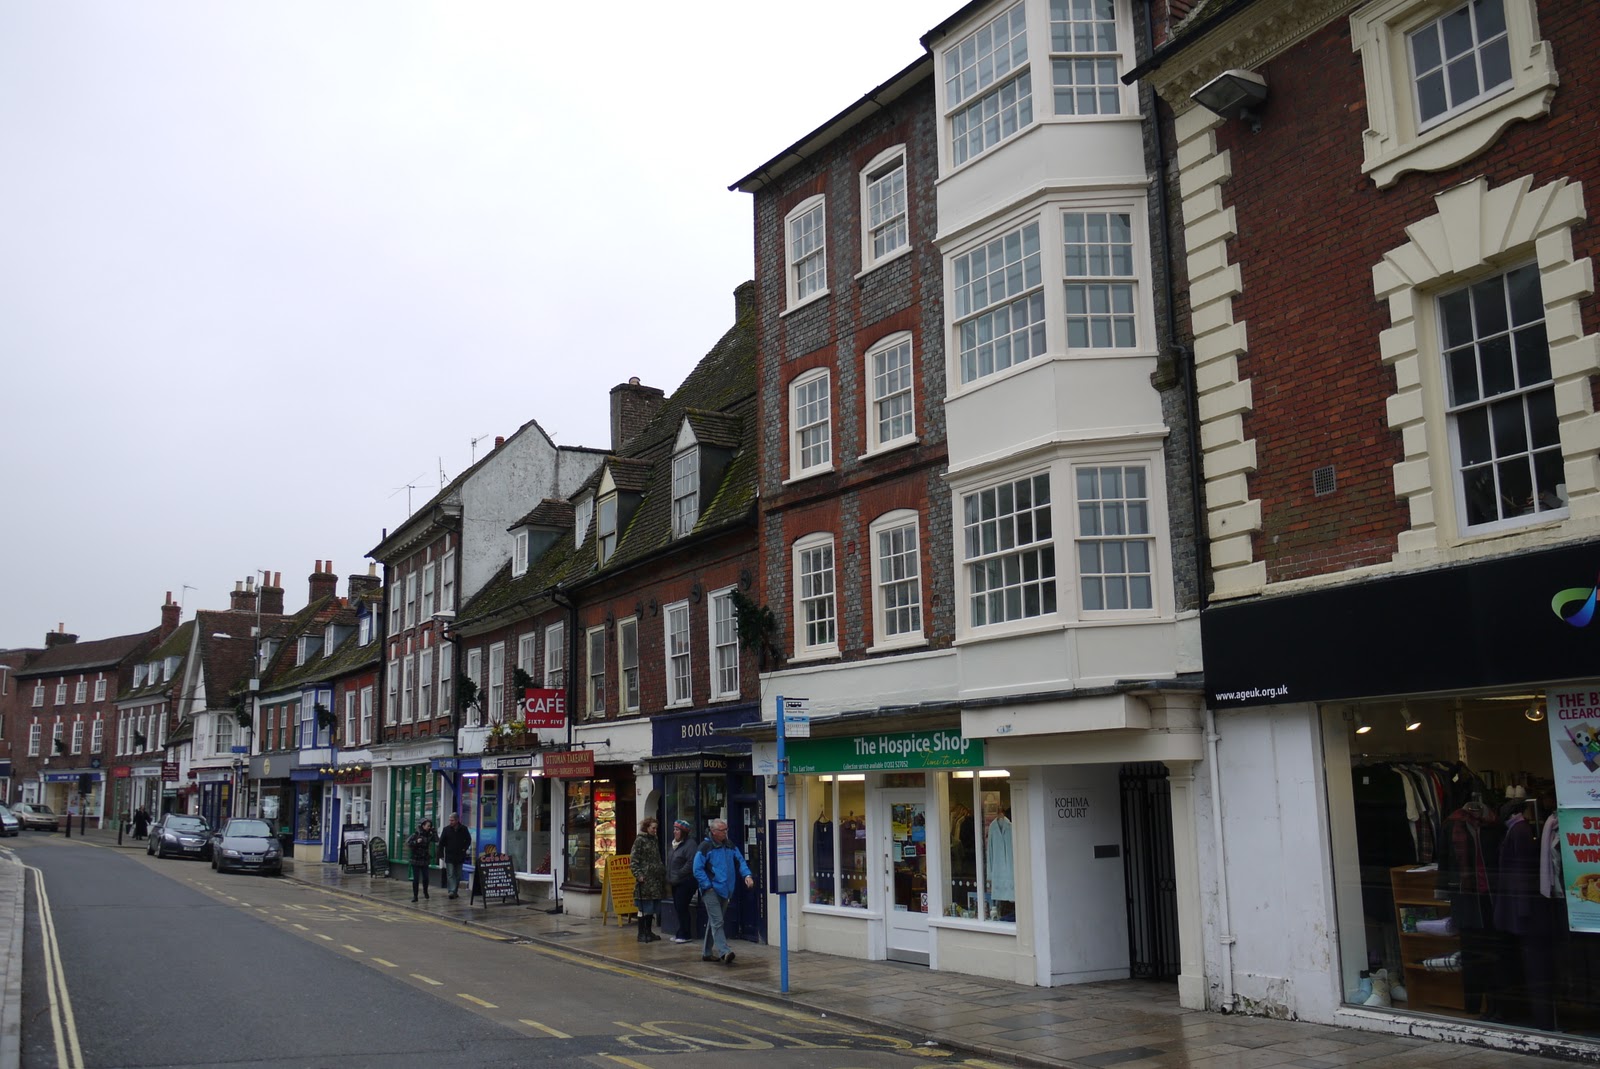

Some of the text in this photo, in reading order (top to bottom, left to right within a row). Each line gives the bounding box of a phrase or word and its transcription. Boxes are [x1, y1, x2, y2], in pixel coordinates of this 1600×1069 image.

[1215, 684, 1288, 701] www.ageuk.org.uk
[1556, 691, 1600, 708] THE B
[525, 692, 564, 713] CAFÉ
[681, 722, 714, 738] BOOKS
[853, 731, 970, 757] The Hospice Shop
[545, 751, 590, 765] OTTOMAN TAKEAWAY
[703, 759, 728, 769] BOOKS
[1054, 797, 1090, 808] KOHIMA
[1057, 808, 1087, 818] COURT
[1582, 816, 1600, 830] ST
[1566, 832, 1600, 846] WAR
[1573, 848, 1600, 863] WIN
